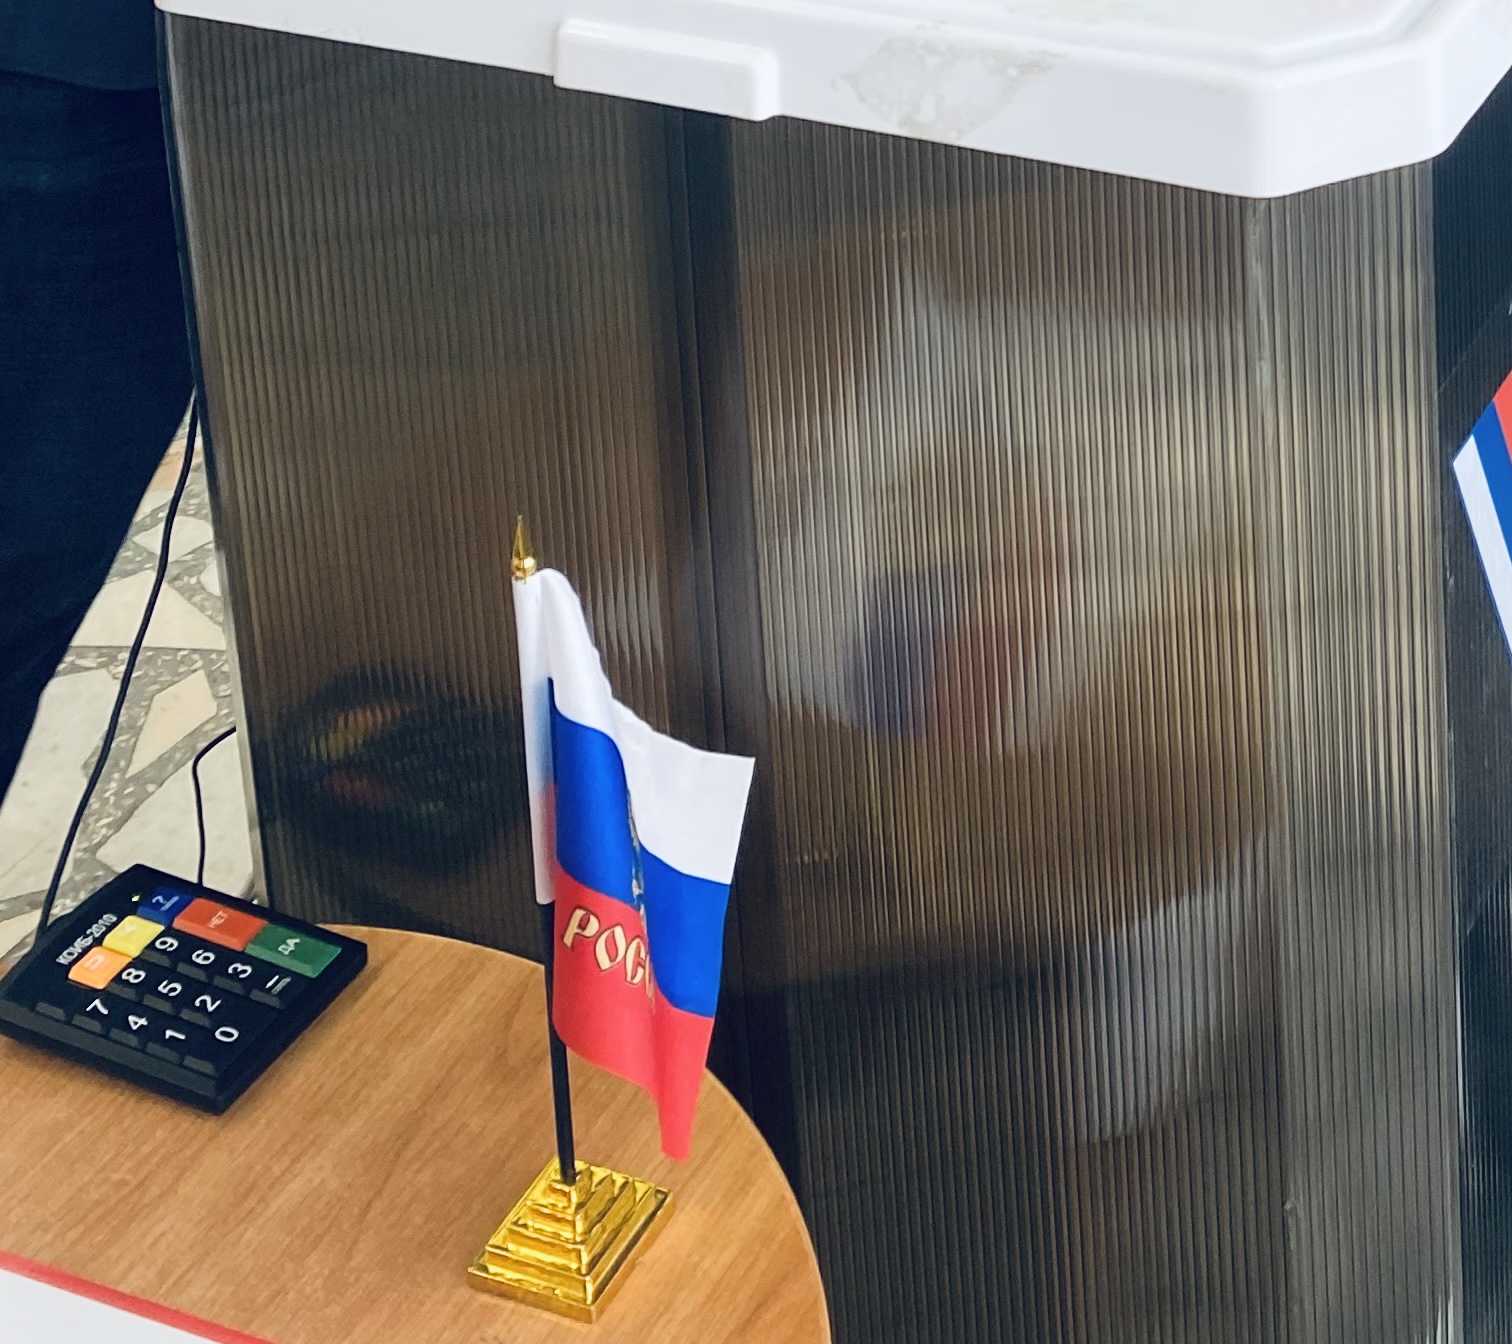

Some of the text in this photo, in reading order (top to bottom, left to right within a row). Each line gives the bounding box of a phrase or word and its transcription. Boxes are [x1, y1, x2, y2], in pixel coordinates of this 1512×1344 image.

[154, 936, 179, 952] 9
[277, 937, 301, 955] ДА
[191, 949, 216, 965] 6
[121, 967, 146, 984] 8
[227, 962, 252, 979] 3
[157, 979, 182, 997] 5
[86, 998, 109, 1016] 7
[194, 994, 222, 1013] 2
[127, 1014, 149, 1031] 4
[164, 1027, 186, 1042] 1
[214, 1026, 240, 1043] 0
